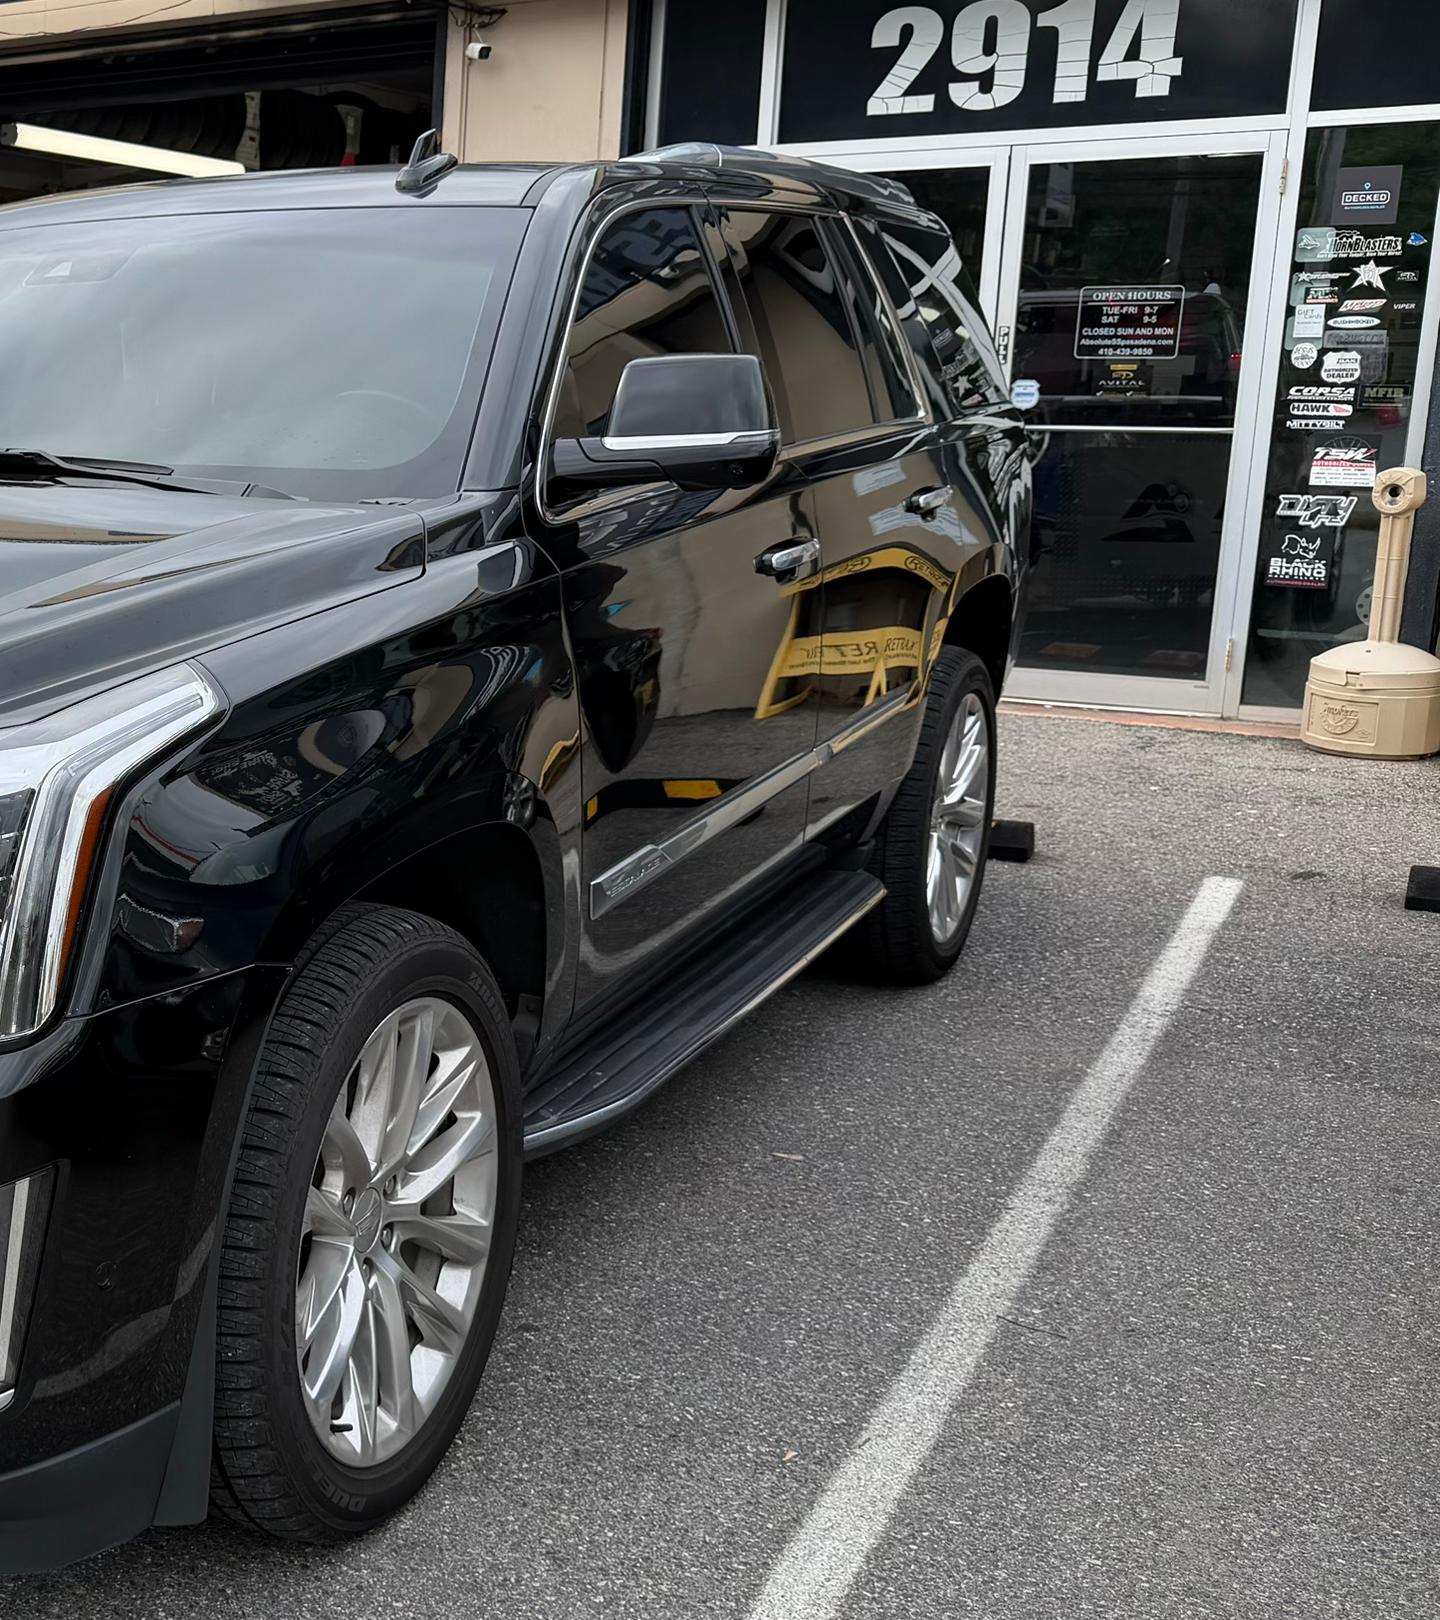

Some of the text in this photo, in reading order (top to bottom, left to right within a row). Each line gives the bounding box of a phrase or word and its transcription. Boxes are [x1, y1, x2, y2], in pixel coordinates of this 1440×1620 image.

[866, 0, 1183, 116] 2914
[1344, 193, 1388, 203] DECKED
[1092, 290, 1172, 301] OPEN HOURS
[1102, 306, 1159, 315] TUE-FRI 9-7
[1297, 308, 1315, 316] GIFT
[1101, 315, 1157, 324] SAT 9-5
[1082, 327, 1174, 336] CLOSED SUN AND MON
[998, 327, 1009, 364] PULL
[1288, 386, 1356, 398] CORSA
[1292, 403, 1330, 413] HAWK
[1312, 447, 1377, 462] TSW
[1270, 557, 1327, 569] BLACK
[1268, 567, 1327, 577] RHINO
